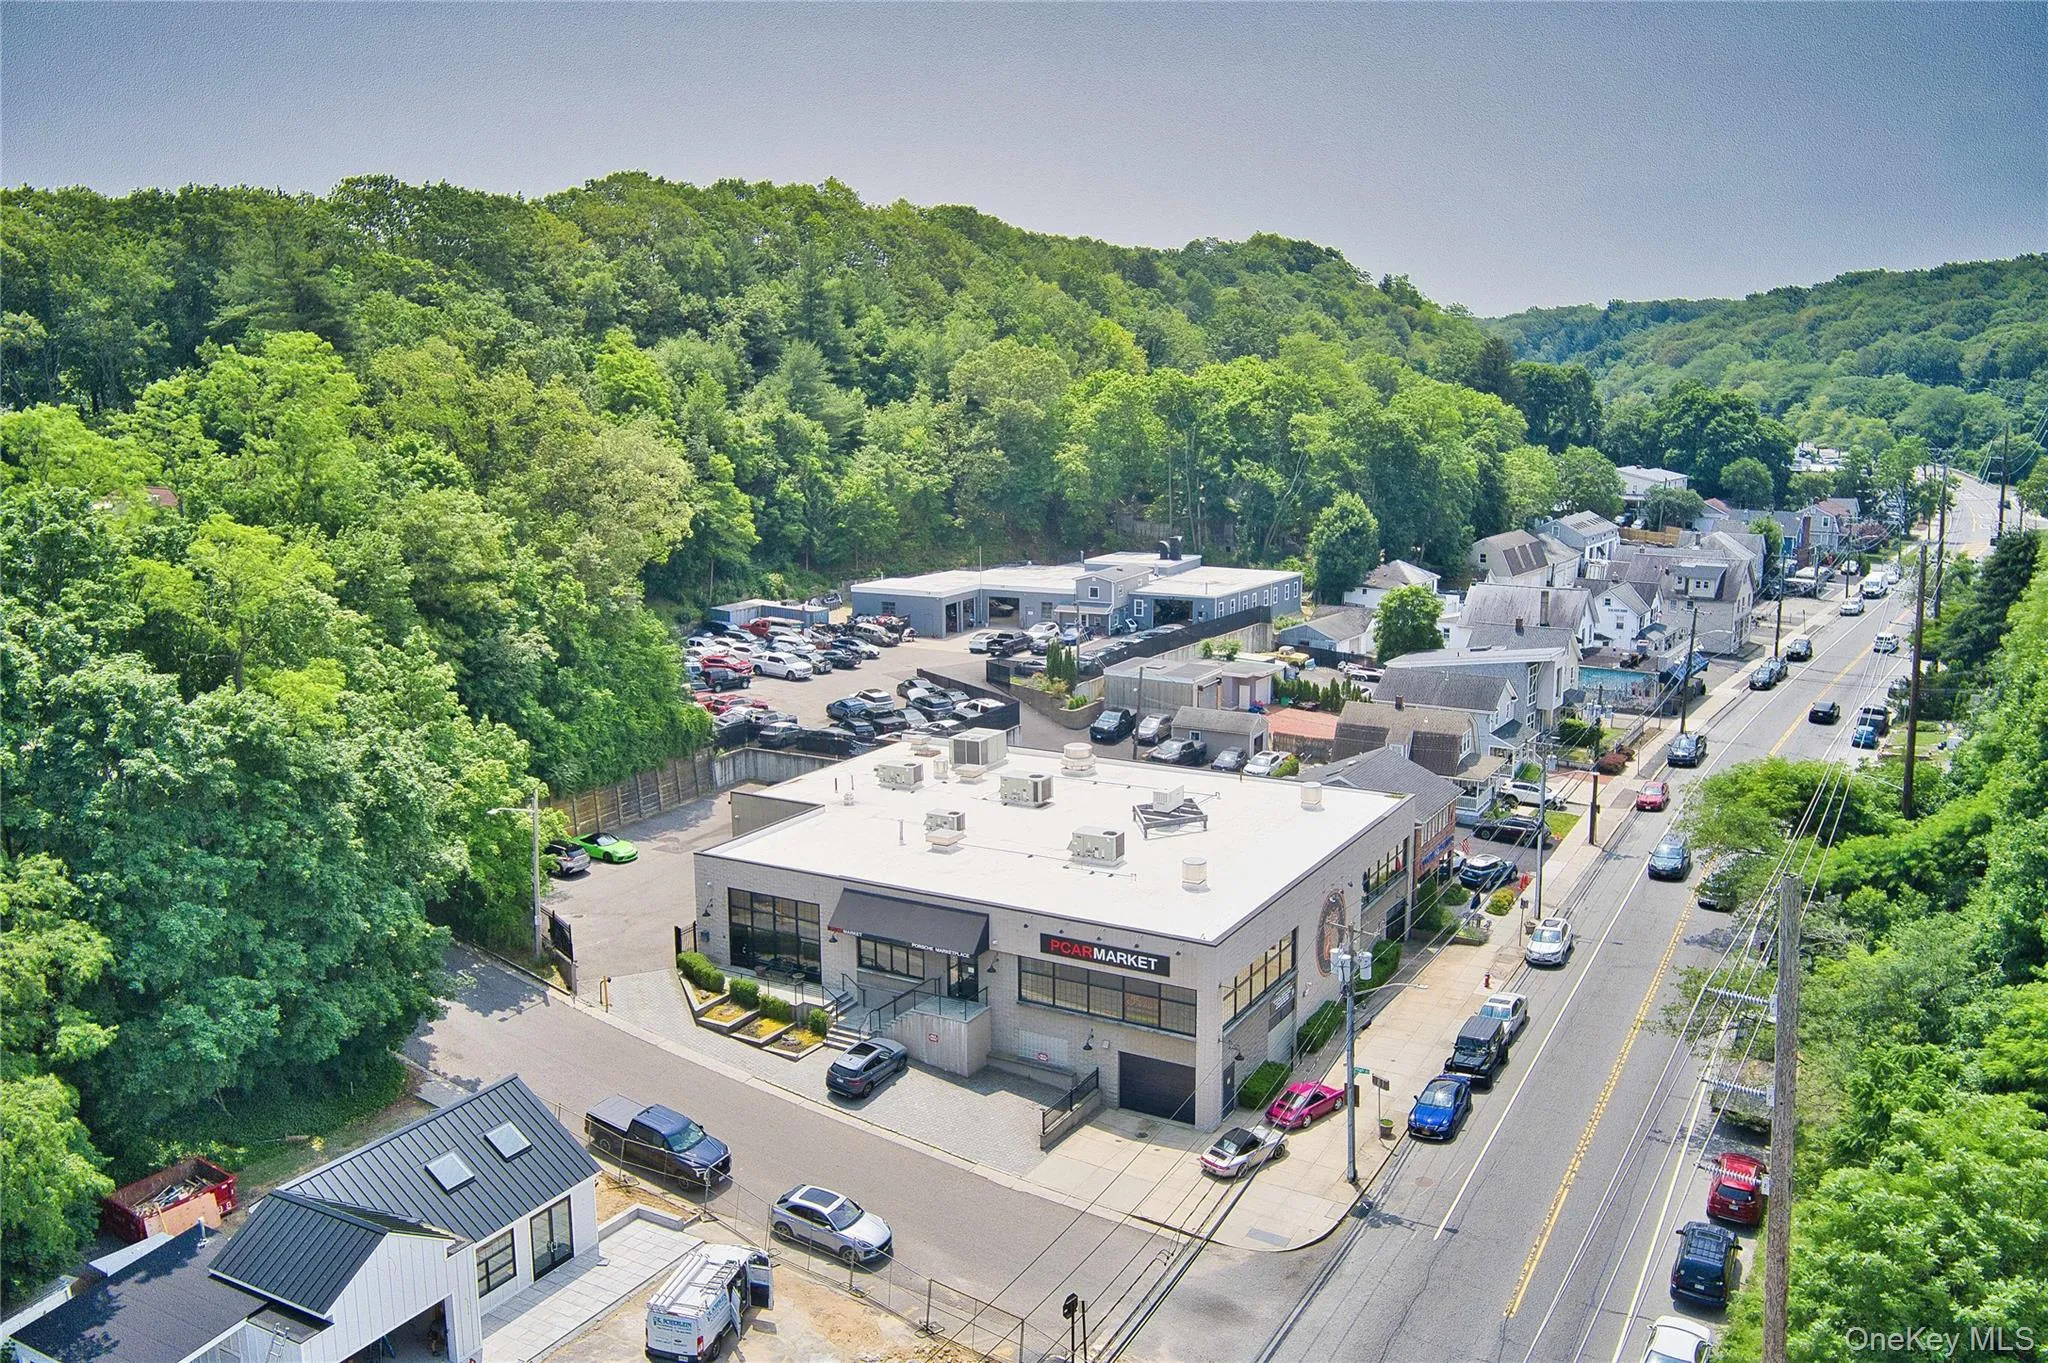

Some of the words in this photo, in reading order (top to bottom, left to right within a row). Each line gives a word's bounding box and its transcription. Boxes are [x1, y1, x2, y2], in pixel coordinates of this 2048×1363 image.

[911, 942, 934, 952] PORSCHE
[935, 947, 970, 959] MARKETPLACE
[1050, 939, 1158, 970] PCARMARKET
